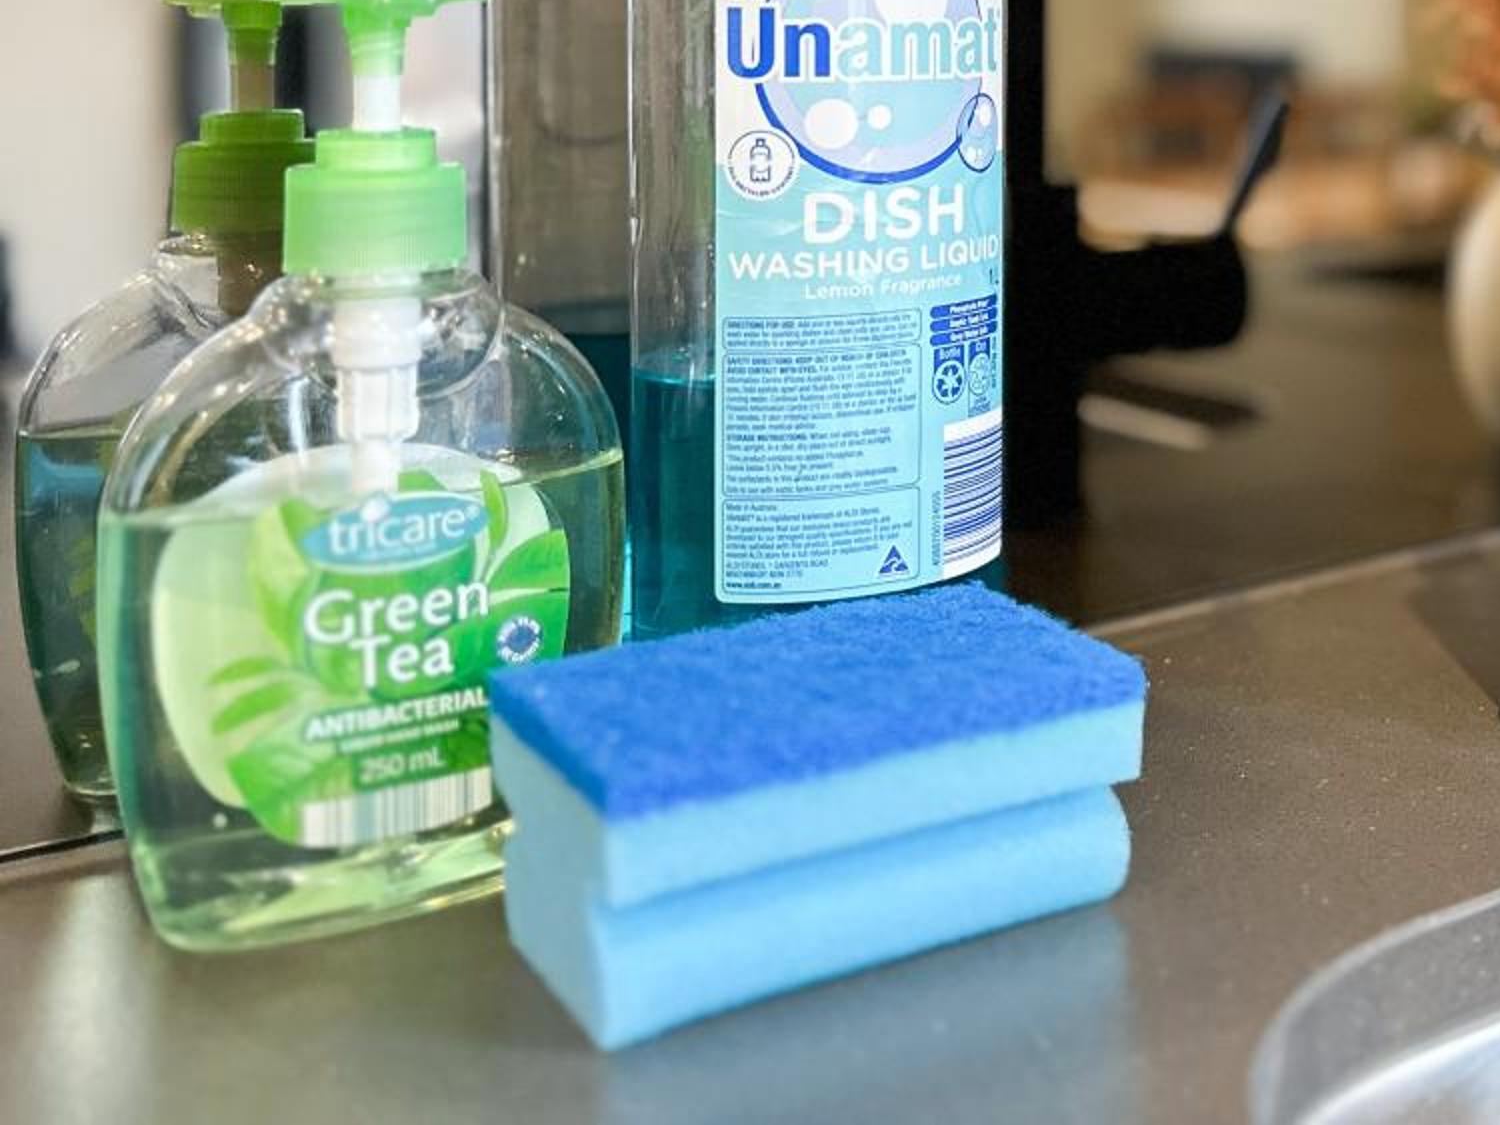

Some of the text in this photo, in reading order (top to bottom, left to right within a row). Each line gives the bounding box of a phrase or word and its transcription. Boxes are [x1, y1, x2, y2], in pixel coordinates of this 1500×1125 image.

[727, 6, 997, 79] Unamat
[803, 183, 964, 244] DISH
[728, 234, 999, 281] WASHING LIQUID
[805, 275, 962, 300] Lemon Fragrance
[328, 496, 466, 556] tricare
[304, 581, 489, 644] Green
[350, 635, 454, 687] Tea
[304, 687, 489, 743] ANTIBACTERIAL
